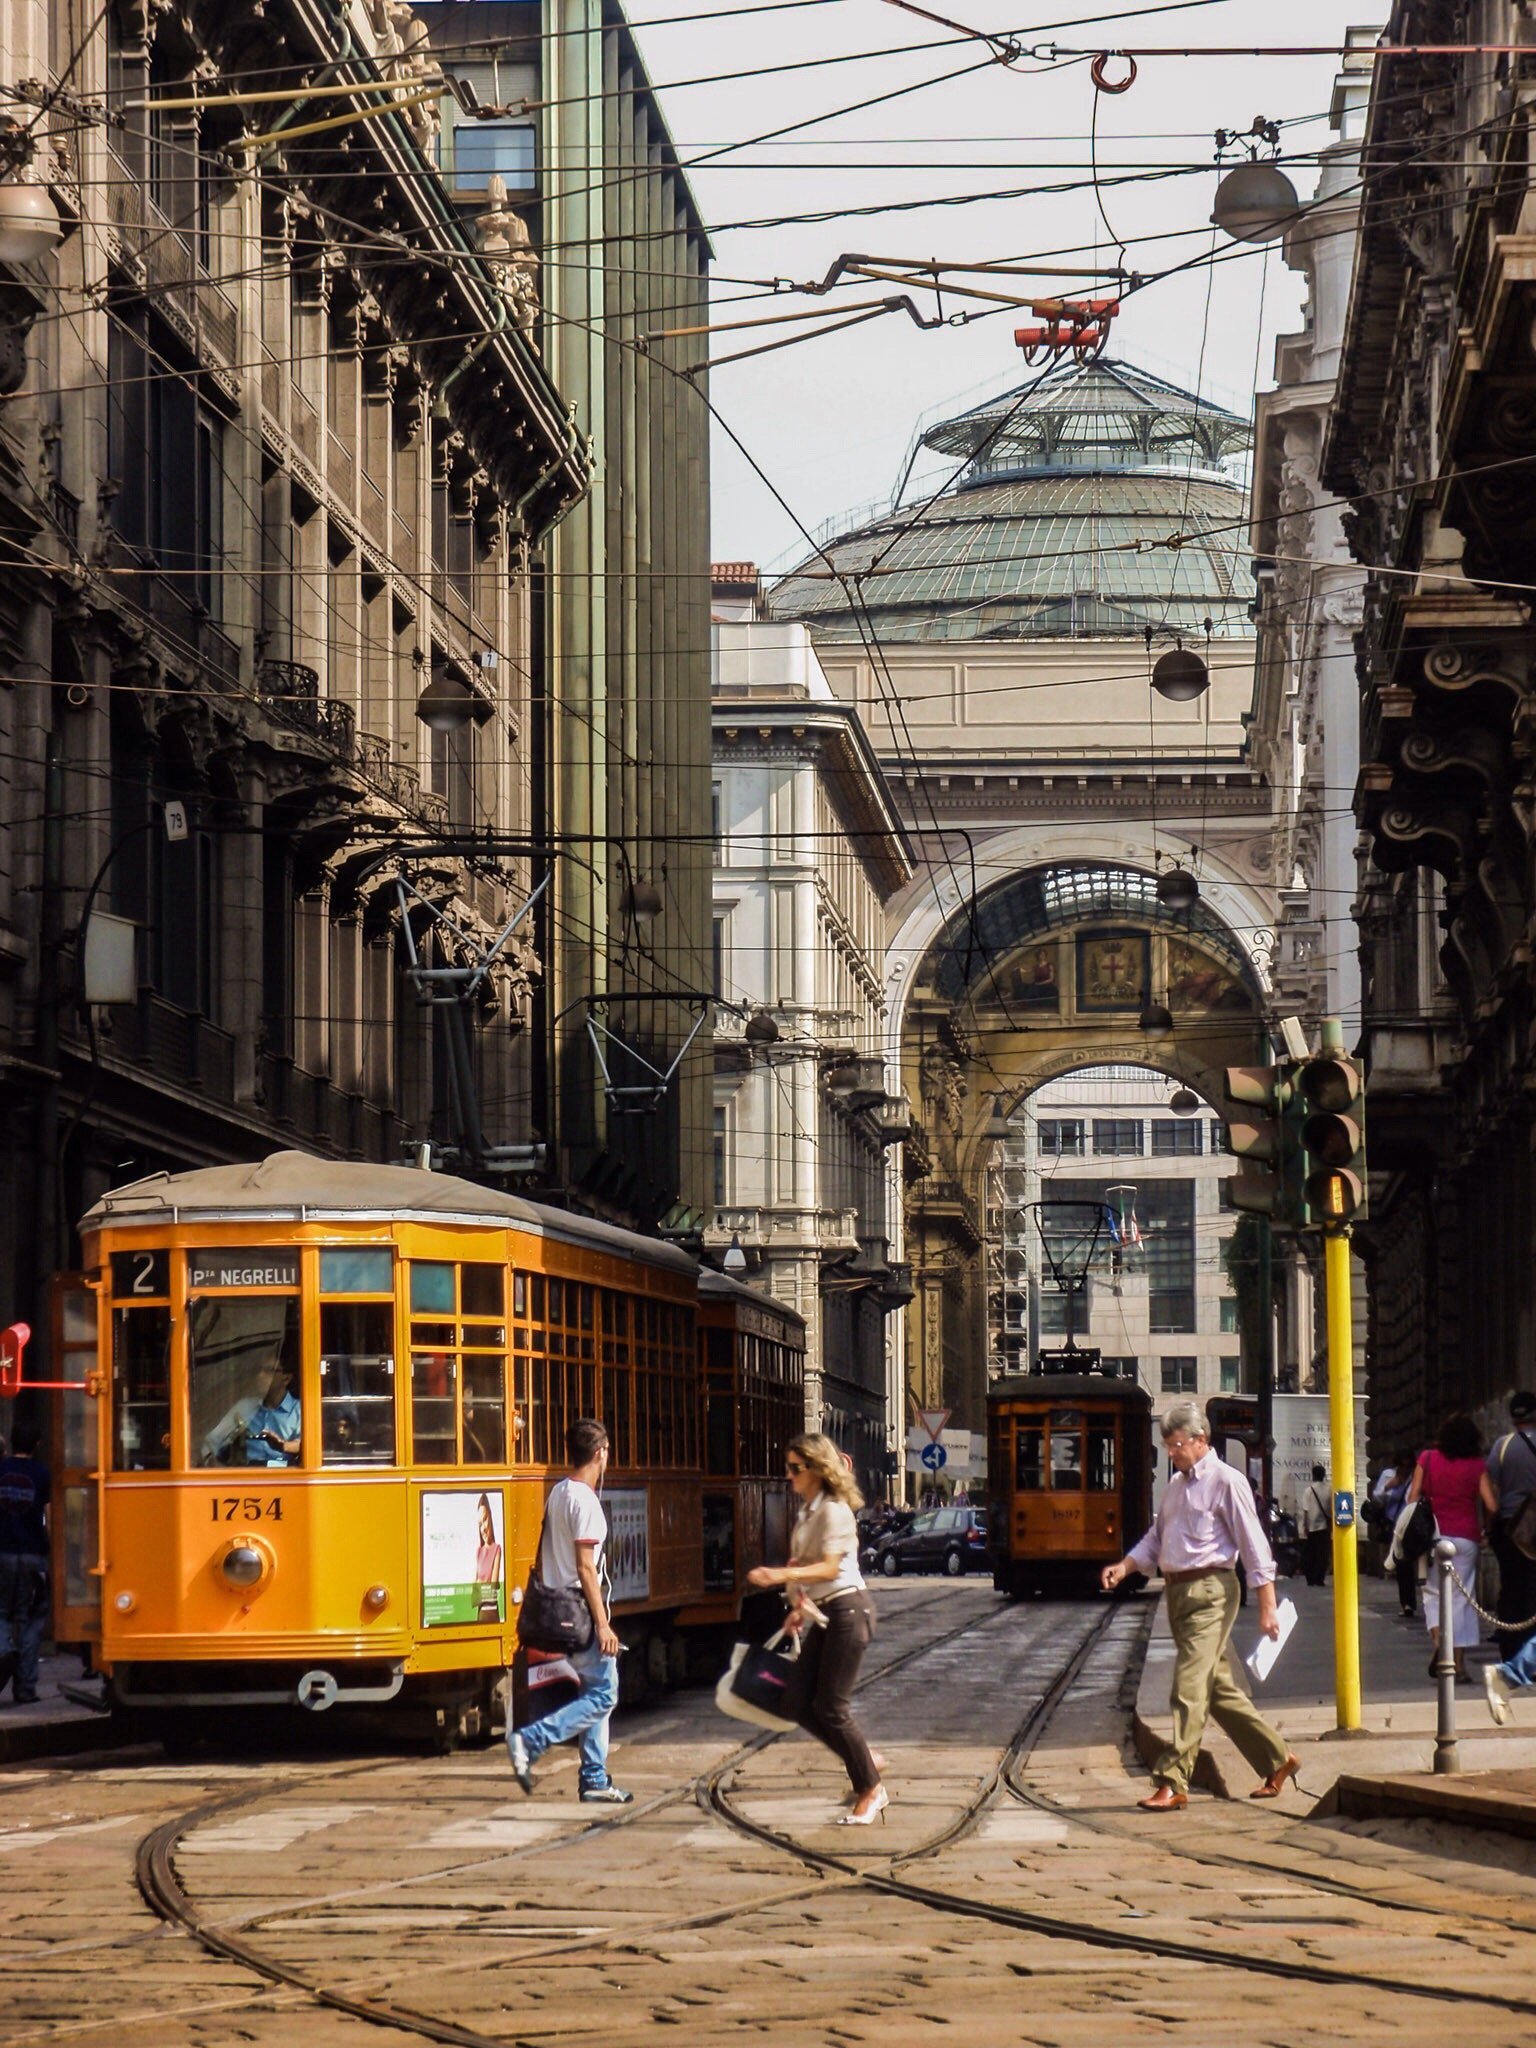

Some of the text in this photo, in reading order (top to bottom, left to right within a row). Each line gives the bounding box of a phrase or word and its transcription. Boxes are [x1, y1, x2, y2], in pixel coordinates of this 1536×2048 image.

[170, 812, 183, 830] 79
[133, 1252, 154, 1293] 2
[221, 1268, 296, 1286] NEGRELLI
[210, 1497, 283, 1522] 1754
